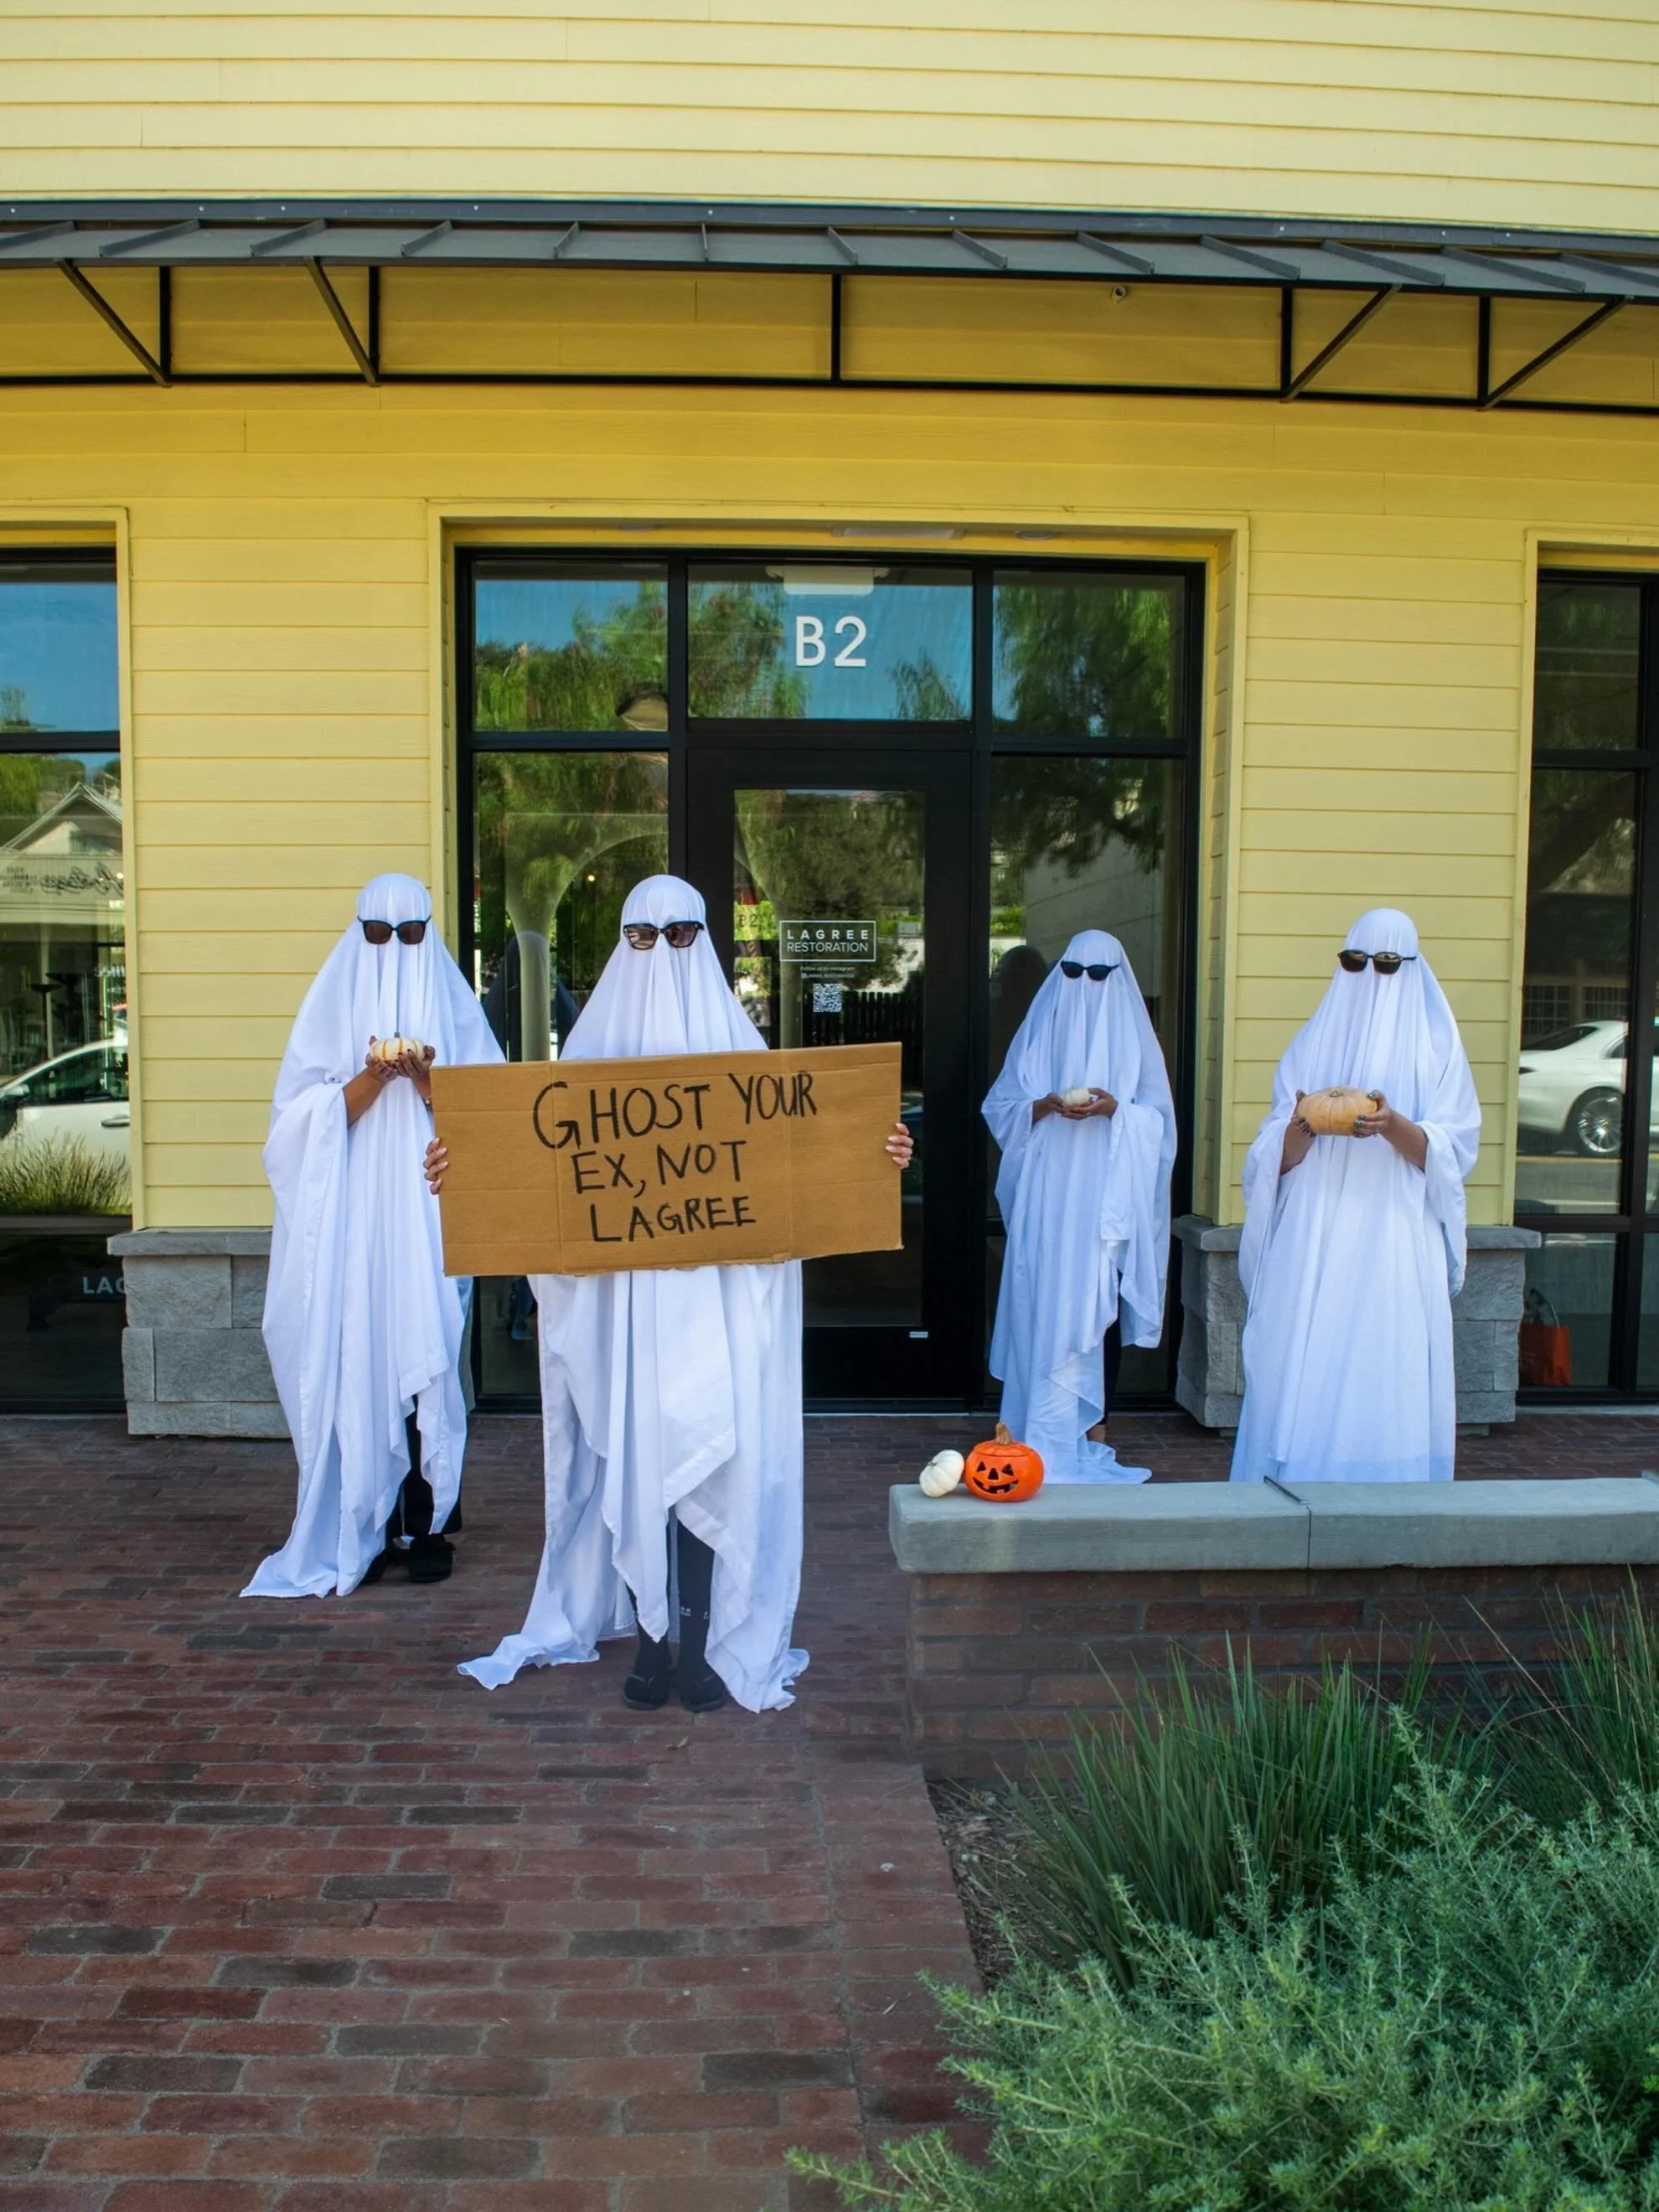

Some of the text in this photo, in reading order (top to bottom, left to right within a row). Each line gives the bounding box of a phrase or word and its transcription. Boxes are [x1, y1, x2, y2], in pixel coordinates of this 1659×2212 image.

[796, 616, 866, 667] B2
[787, 929, 869, 940] LAGREE
[787, 942, 868, 953] RESTORATION
[533, 1071, 818, 1150] GHOST YOUR
[571, 1140, 747, 1198] EX, NOT
[589, 1196, 757, 1243] LAGREE
